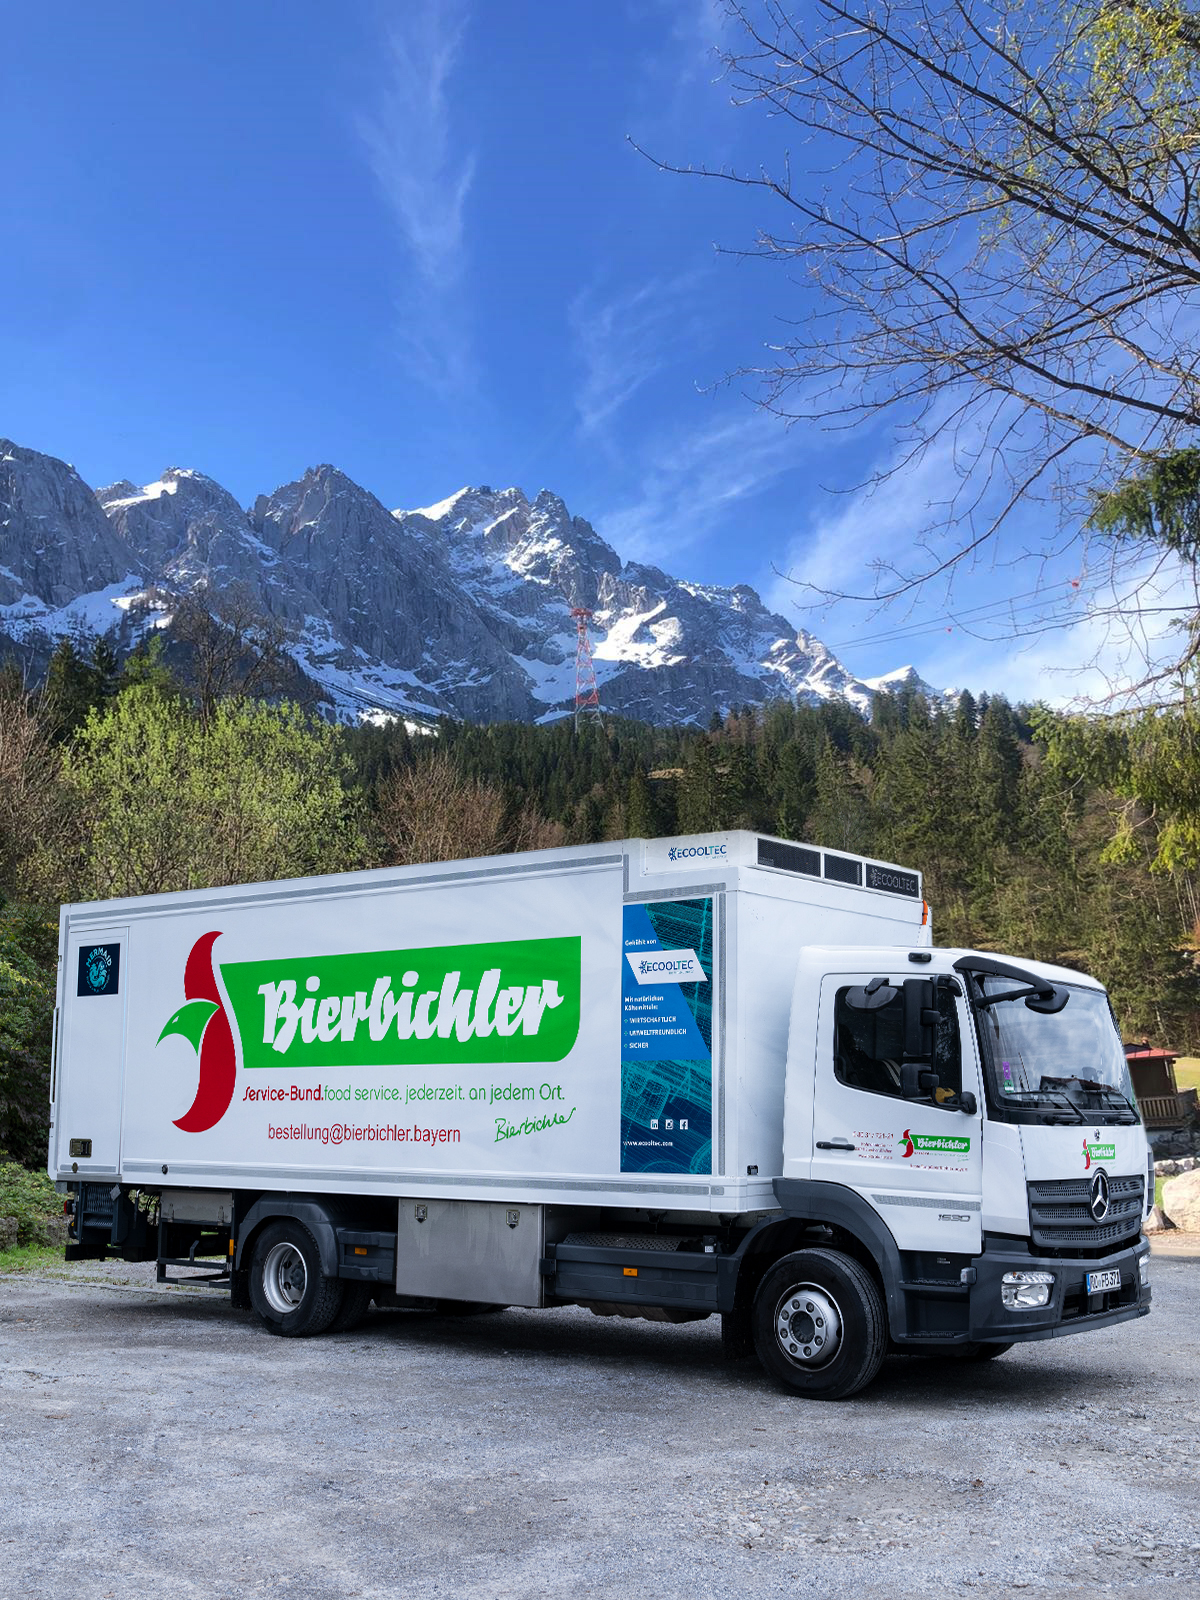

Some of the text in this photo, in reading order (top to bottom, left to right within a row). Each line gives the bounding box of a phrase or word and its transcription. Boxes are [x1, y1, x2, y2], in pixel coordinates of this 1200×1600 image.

[677, 844, 727, 859] ECOOLTEC
[85, 947, 112, 968] MERMAID
[646, 960, 694, 972] ECOOLTEC
[257, 968, 564, 1054] Bierbichler
[629, 1016, 677, 1024] WIRTSCHAFTLICH
[629, 1028, 687, 1036] UMWELTFREUNDLICH
[354, 1084, 403, 1101] service.
[404, 1083, 466, 1106] jederzeit.
[468, 1087, 487, 1101] an
[489, 1082, 535, 1106] jedem
[539, 1082, 566, 1101] Ort.
[267, 1123, 461, 1147] bestellung@bierbichler.bayern
[622, 1139, 673, 1147] www.ecooltec.com
[916, 1137, 969, 1150] Bierbichler
